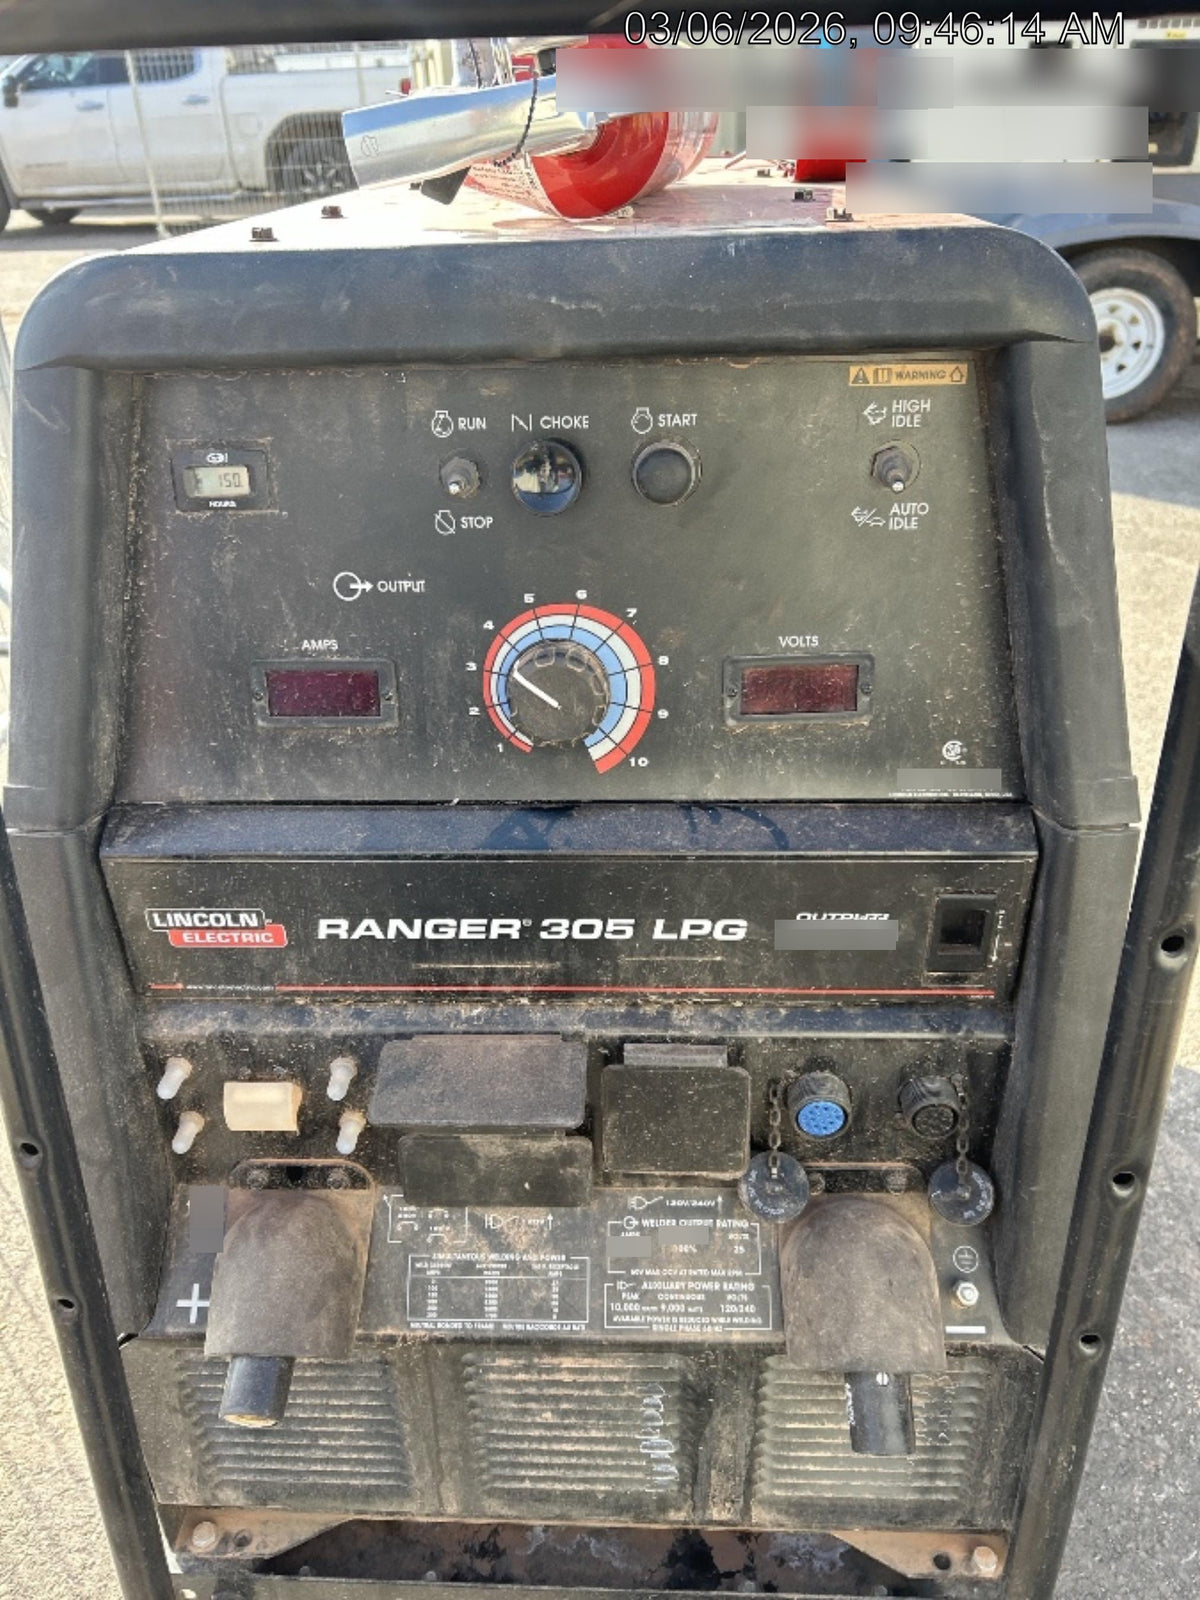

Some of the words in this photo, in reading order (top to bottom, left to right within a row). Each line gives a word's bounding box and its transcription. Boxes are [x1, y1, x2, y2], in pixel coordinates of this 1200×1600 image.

[895, 369, 947, 381] WARNING
[892, 399, 931, 413] HIGH
[458, 417, 487, 430] RUN
[540, 415, 590, 430] CHOKE
[657, 413, 697, 427] START
[891, 414, 922, 428] IDLE
[889, 502, 929, 516] AUTO
[460, 516, 493, 529] STOP
[888, 516, 919, 531] IDLE
[377, 580, 426, 593] OUTPUT
[524, 593, 536, 603] 5
[576, 590, 588, 599] 6
[626, 608, 638, 618] 7
[483, 620, 495, 630] 4
[301, 639, 338, 651] AMPS
[778, 636, 819, 648] VOLTS
[465, 663, 478, 671] 3
[658, 656, 670, 666] 8
[468, 707, 480, 716] 2
[657, 709, 669, 719] 9
[497, 743, 504, 753] 1
[629, 757, 650, 767] 10
[152, 912, 259, 927] LINCOLN
[539, 918, 636, 940] 305
[652, 918, 749, 941] LPG
[182, 932, 275, 943] ELECTRIC
[641, 1219, 676, 1228] WELDER
[716, 1219, 749, 1228] RATING
[688, 1282, 721, 1291] POWER
